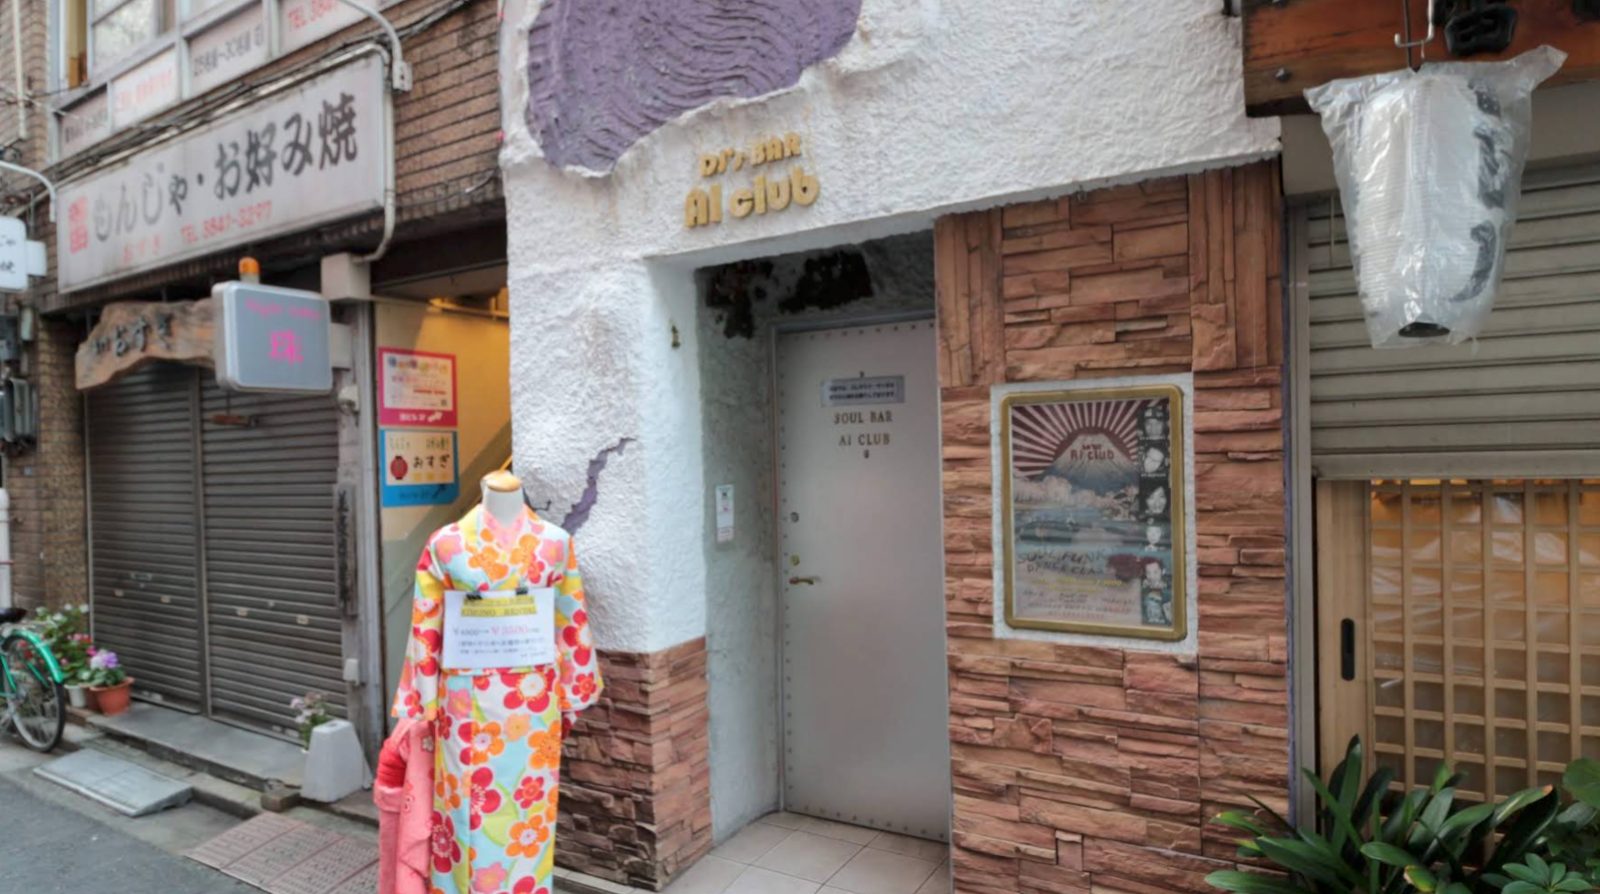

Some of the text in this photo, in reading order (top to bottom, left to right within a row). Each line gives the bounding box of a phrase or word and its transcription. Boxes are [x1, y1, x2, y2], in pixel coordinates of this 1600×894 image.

[751, 131, 801, 167] BAR
[729, 165, 820, 219] club
[833, 409, 894, 425] SOUL BAR
[858, 432, 891, 446] CLUB
[413, 453, 450, 469] おすぎ
